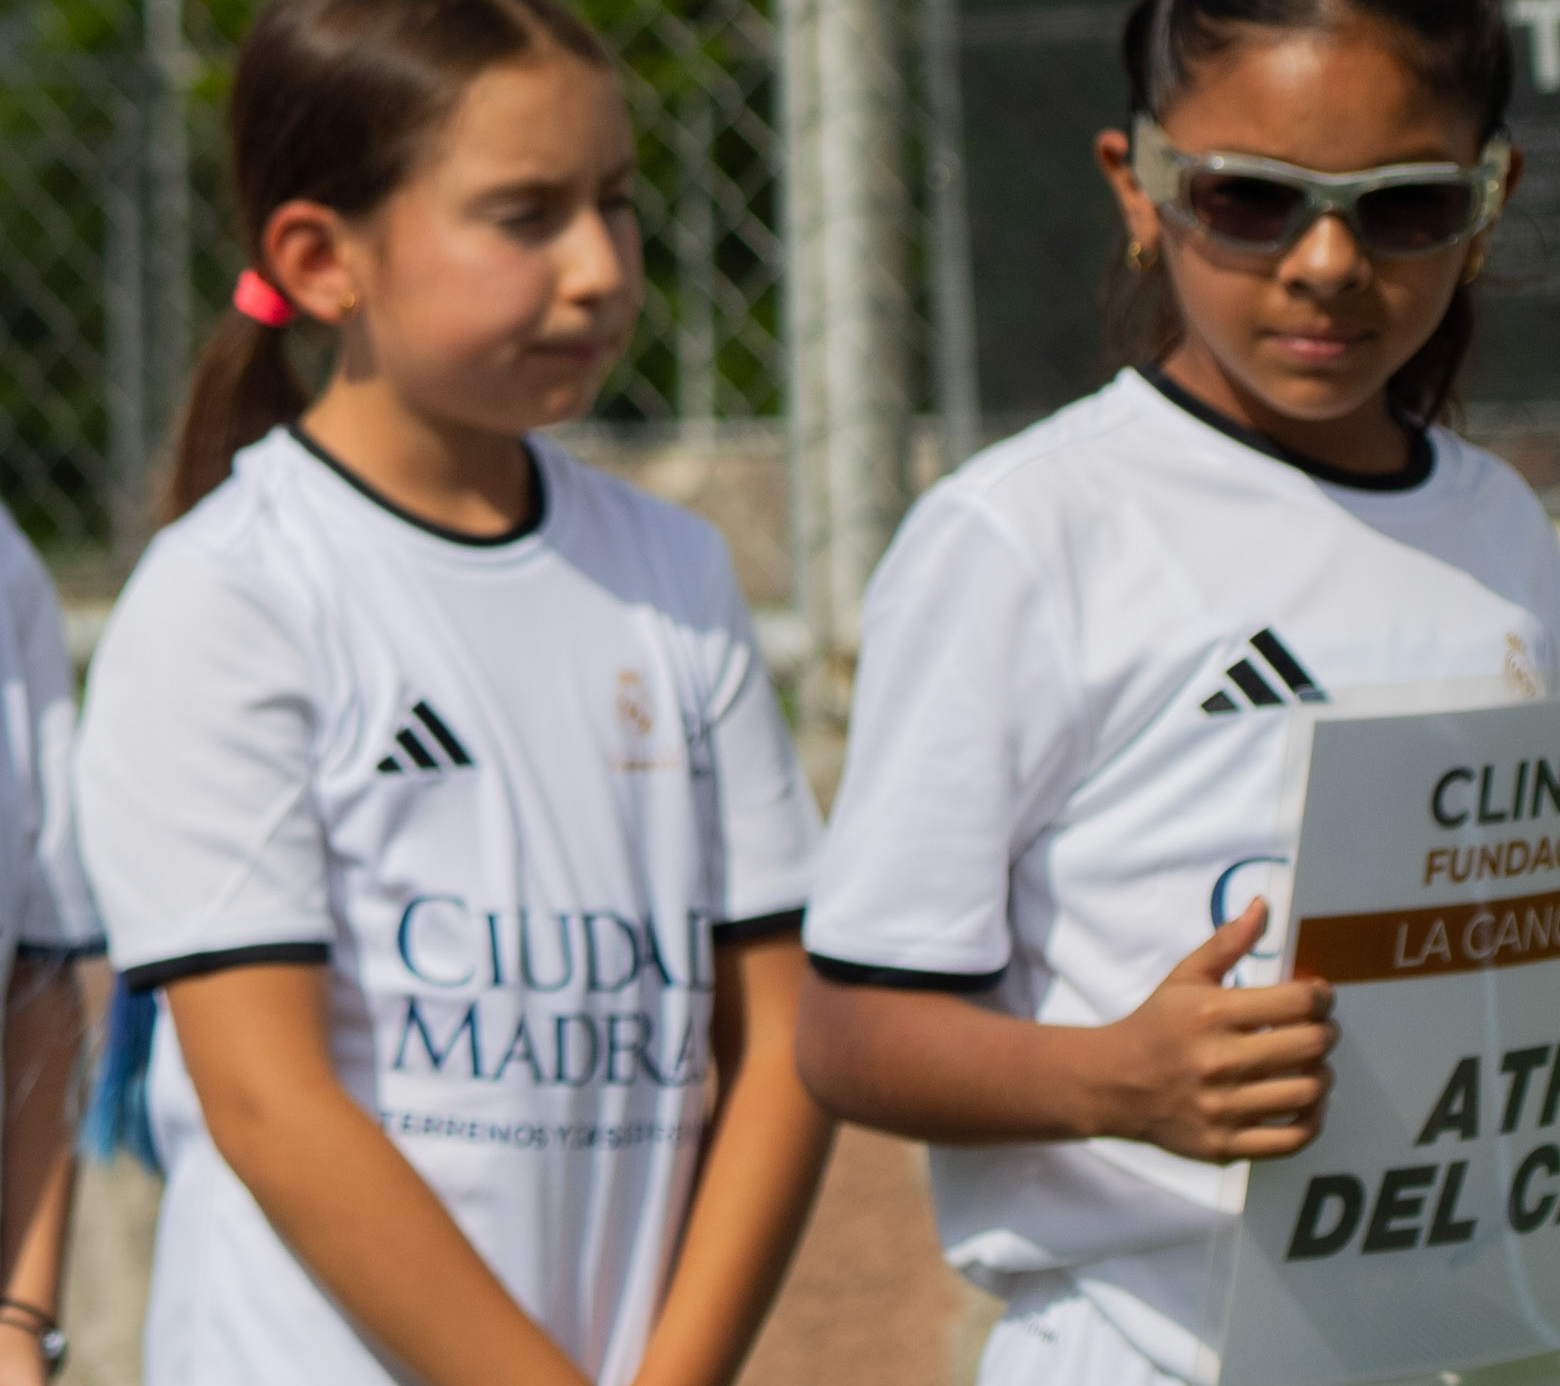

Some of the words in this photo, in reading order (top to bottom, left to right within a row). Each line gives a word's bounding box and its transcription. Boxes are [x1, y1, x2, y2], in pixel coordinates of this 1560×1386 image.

[1394, 918, 1451, 969] LA
[1461, 905, 1560, 960] CAN
[1285, 1160, 1478, 1262] DEL
